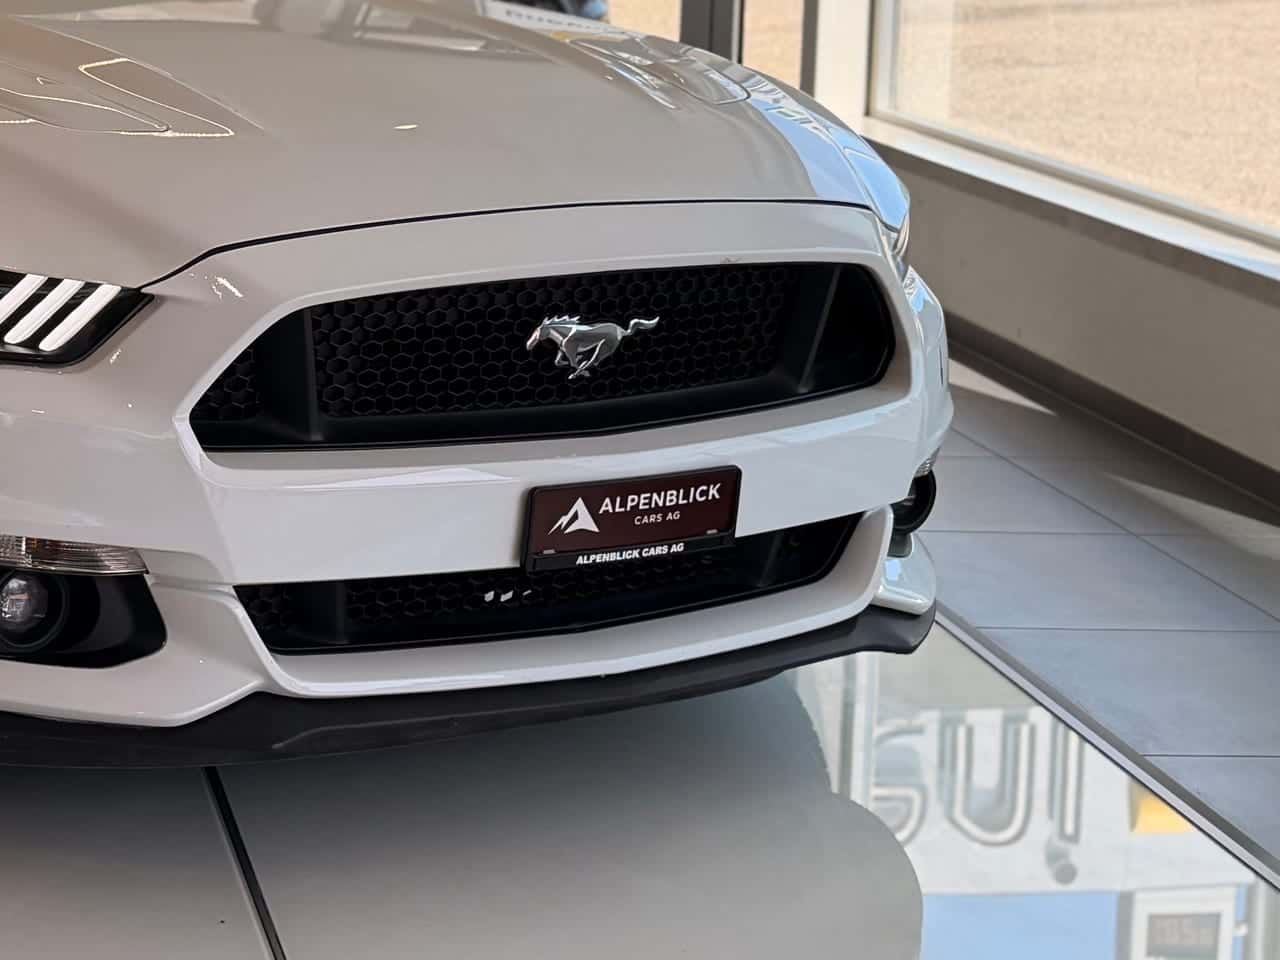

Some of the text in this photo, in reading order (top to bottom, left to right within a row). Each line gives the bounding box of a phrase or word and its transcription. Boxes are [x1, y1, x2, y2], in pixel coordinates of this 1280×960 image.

[599, 483, 721, 514] ALPENBLICK
[634, 511, 681, 525] CARS AG
[576, 542, 685, 565] ALPENBLICK CARS AG
